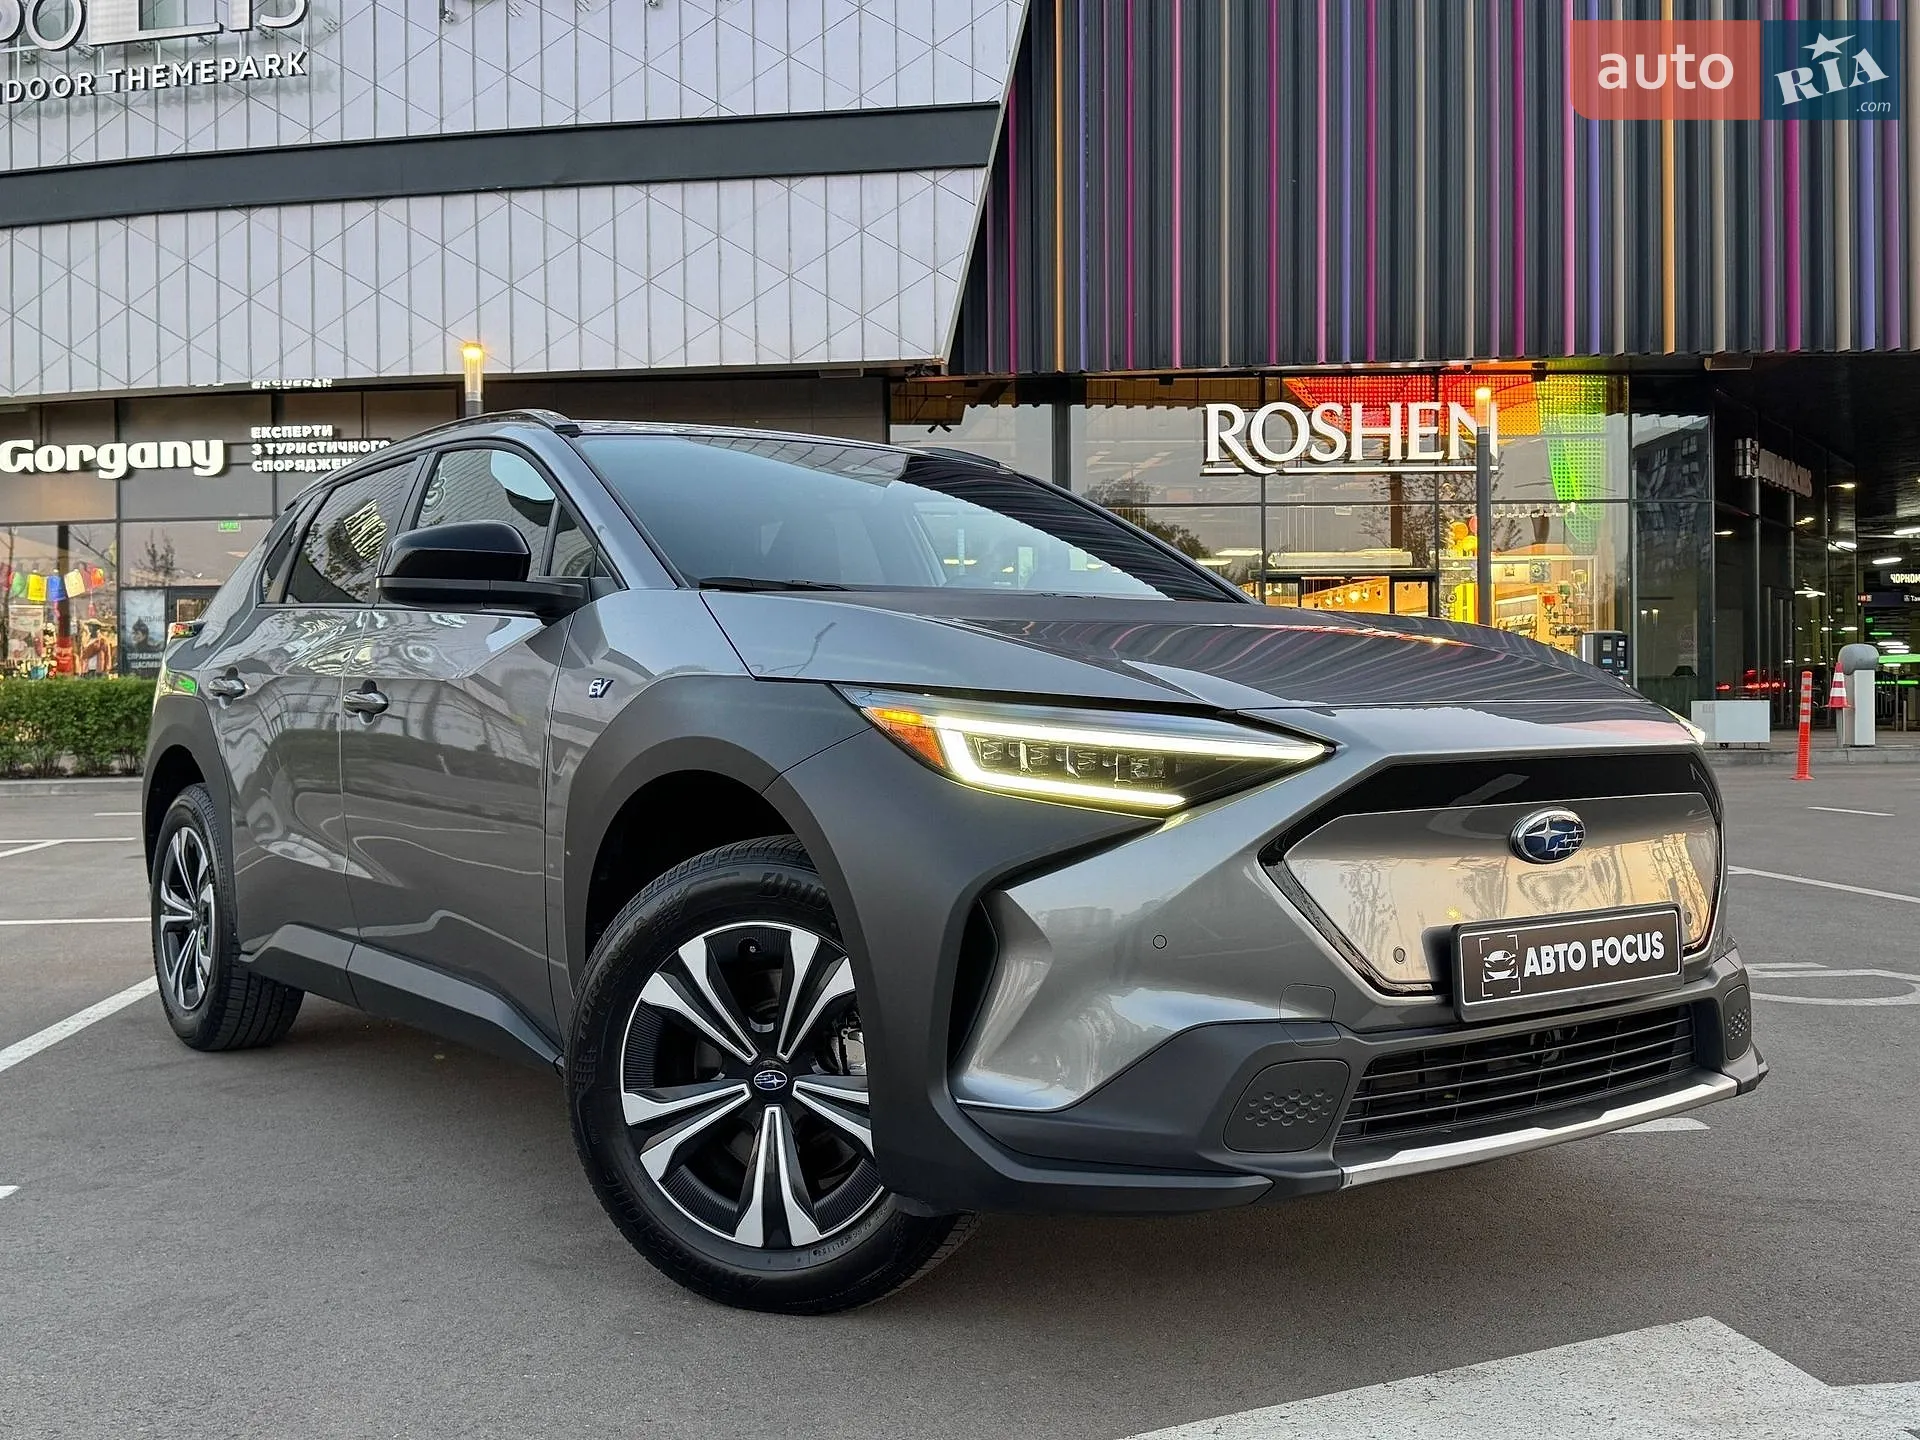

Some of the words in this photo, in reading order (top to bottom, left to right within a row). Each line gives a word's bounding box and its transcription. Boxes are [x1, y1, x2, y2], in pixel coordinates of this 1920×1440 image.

[0, 71, 96, 104] DOOR
[106, 50, 309, 93] THEMEPARK
[251, 424, 333, 439] ЕКСПЕРТИ
[251, 443, 263, 456] З
[1204, 401, 1498, 475] ROSHEN
[0, 439, 224, 480] Gorgany
[251, 458, 357, 473] СПОРЯДЖЕН
[1523, 941, 1587, 977] АВТО
[1592, 931, 1665, 968] FOCUS
